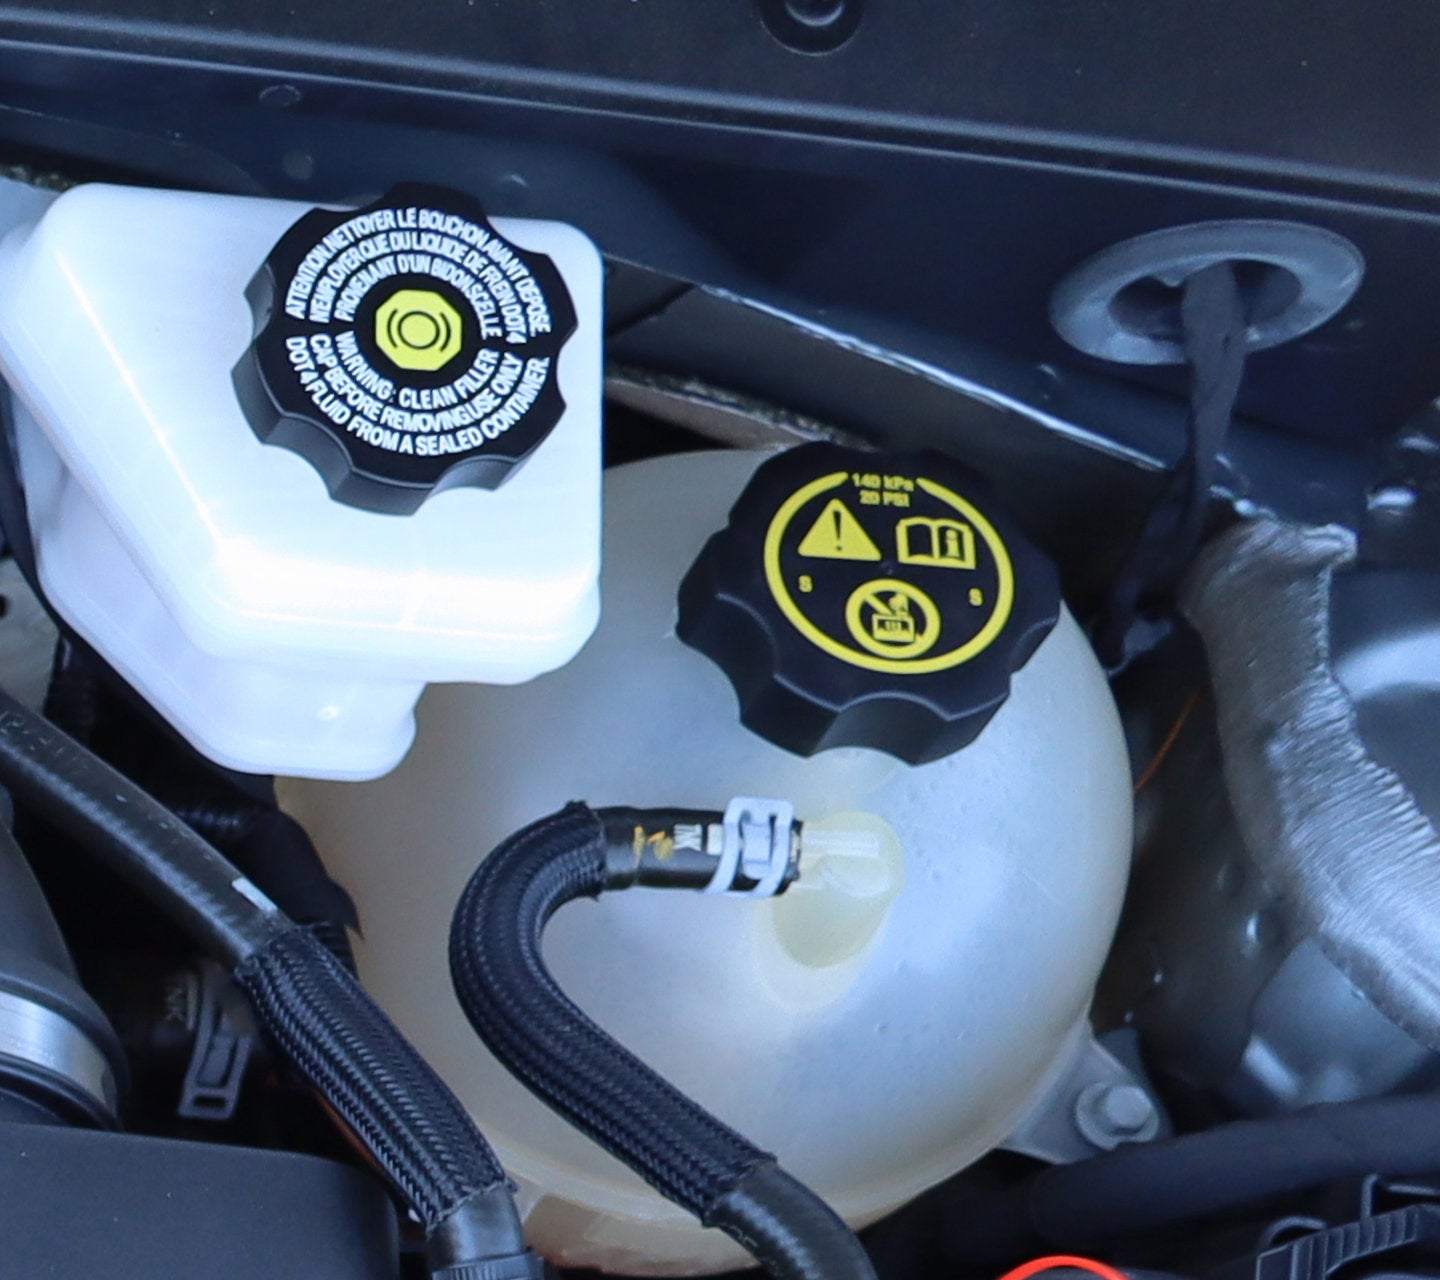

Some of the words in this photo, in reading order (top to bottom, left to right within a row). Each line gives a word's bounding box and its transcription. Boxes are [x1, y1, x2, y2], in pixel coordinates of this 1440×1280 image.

[323, 210, 396, 257] NETTOYER
[397, 208, 416, 228] LE
[418, 209, 489, 249] BOUCHON
[480, 239, 529, 280] AVANT
[358, 230, 391, 259] QUE
[389, 226, 411, 251] DU
[411, 229, 472, 263] LIQUIDE
[463, 250, 488, 275] DE
[477, 265, 517, 306] FREIN
[334, 252, 396, 321] PROVENANT
[463, 277, 502, 339] SCELLE
[310, 334, 338, 373] CAP
[324, 366, 383, 421] BEFORE
[375, 400, 475, 436] REMOVING
[465, 388, 501, 420] USE
[491, 353, 523, 395] ONLY
[335, 331, 396, 402] WARNING:
[399, 386, 458, 409] CLEAN
[453, 349, 499, 399] FILLER
[305, 379, 351, 424] FLUID
[347, 415, 399, 451] FROM
[399, 434, 413, 454] A
[415, 419, 483, 455] SEALED
[852, 473, 881, 490] 140
[883, 474, 914, 492] kPa
[859, 490, 880, 505] 20
[883, 490, 910, 508] PSI
